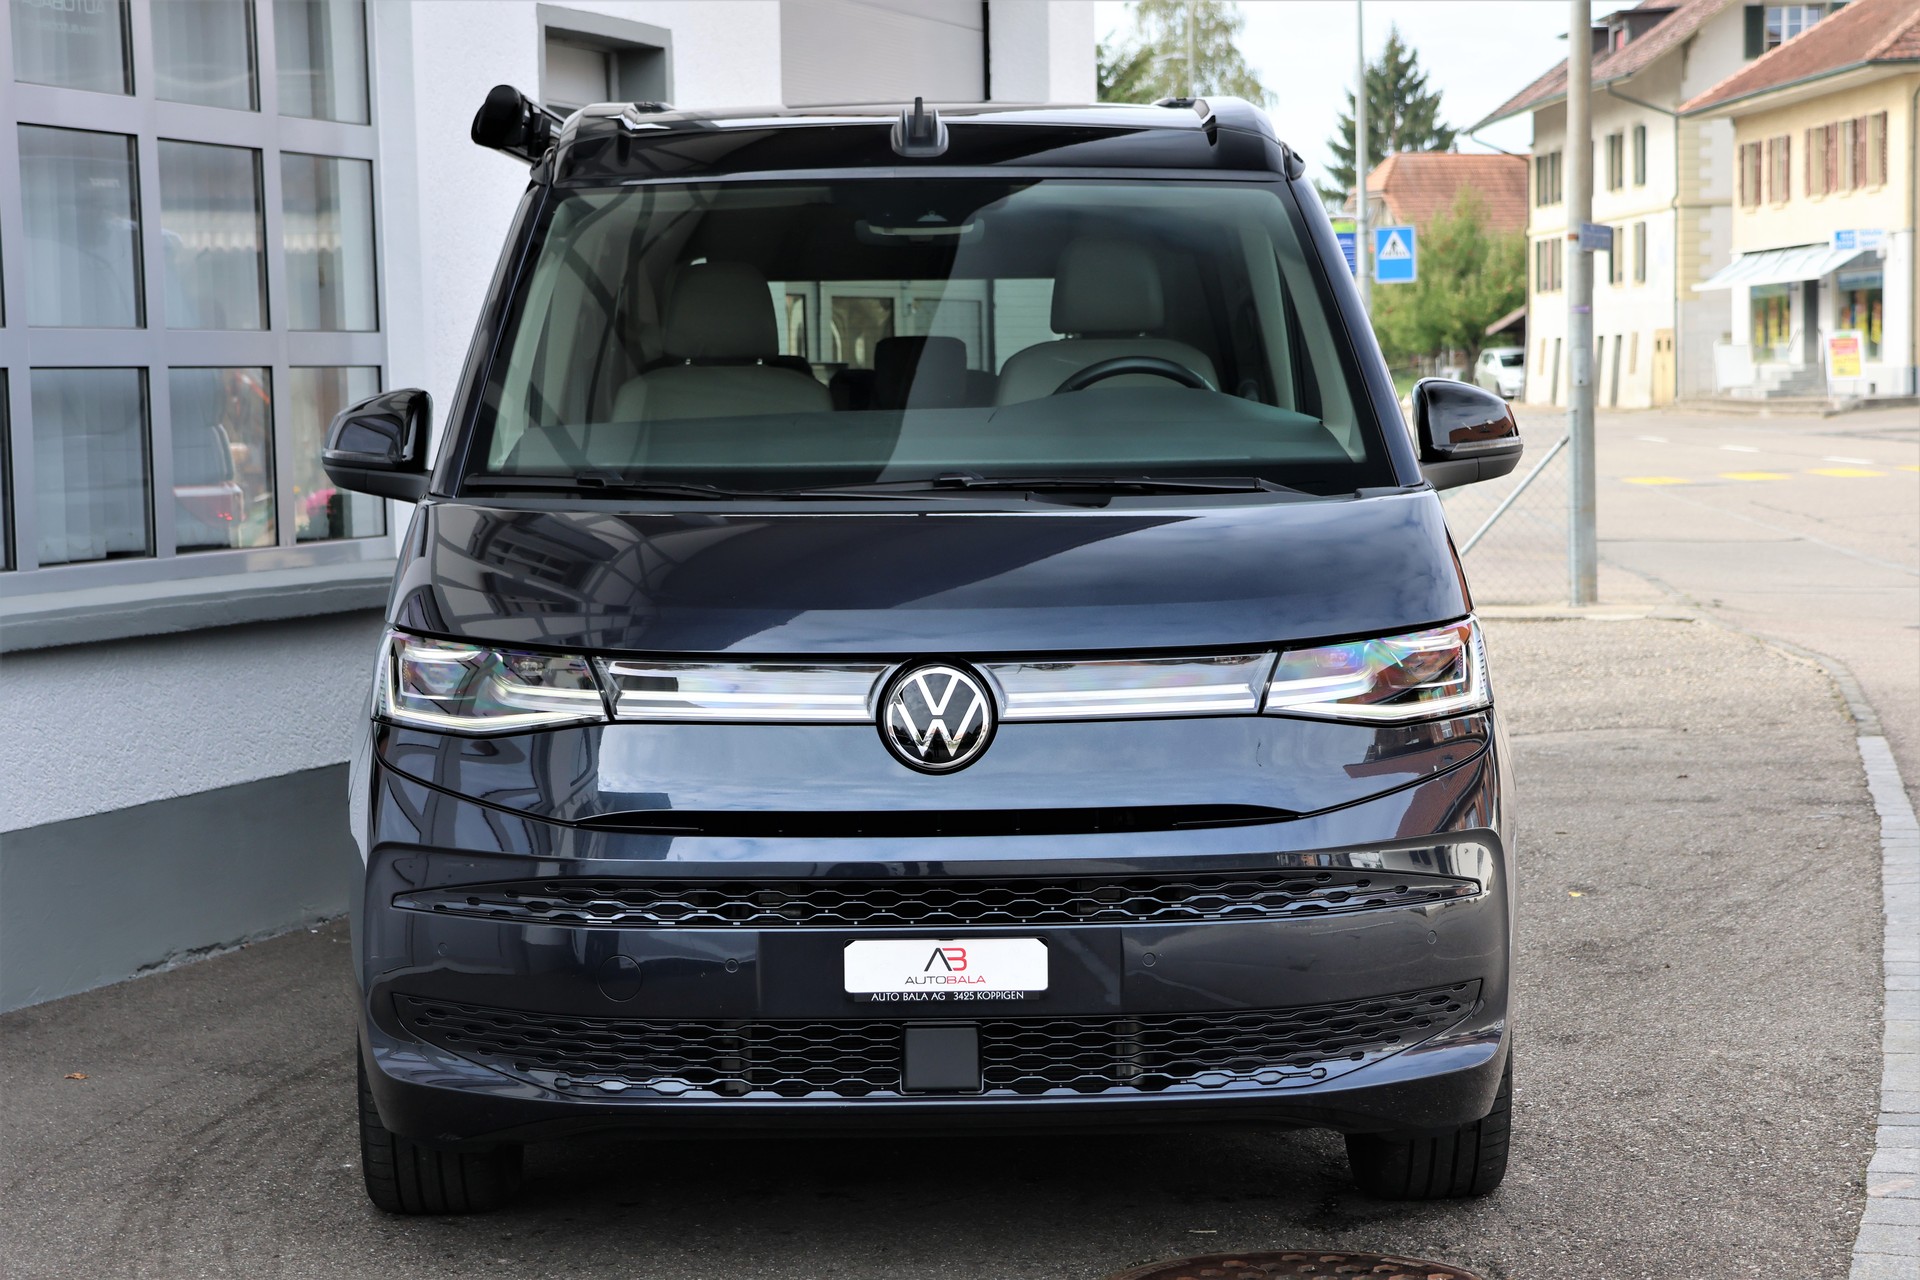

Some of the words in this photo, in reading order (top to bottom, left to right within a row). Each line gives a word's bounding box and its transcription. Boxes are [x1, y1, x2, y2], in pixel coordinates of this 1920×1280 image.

[905, 975, 986, 985] AUTOBALA
[871, 992, 900, 1001] AUTO
[903, 991, 928, 1001] BALA
[931, 991, 946, 1001] AG
[953, 991, 975, 1000] 3425
[977, 990, 1024, 1000] KOPPIGEN
